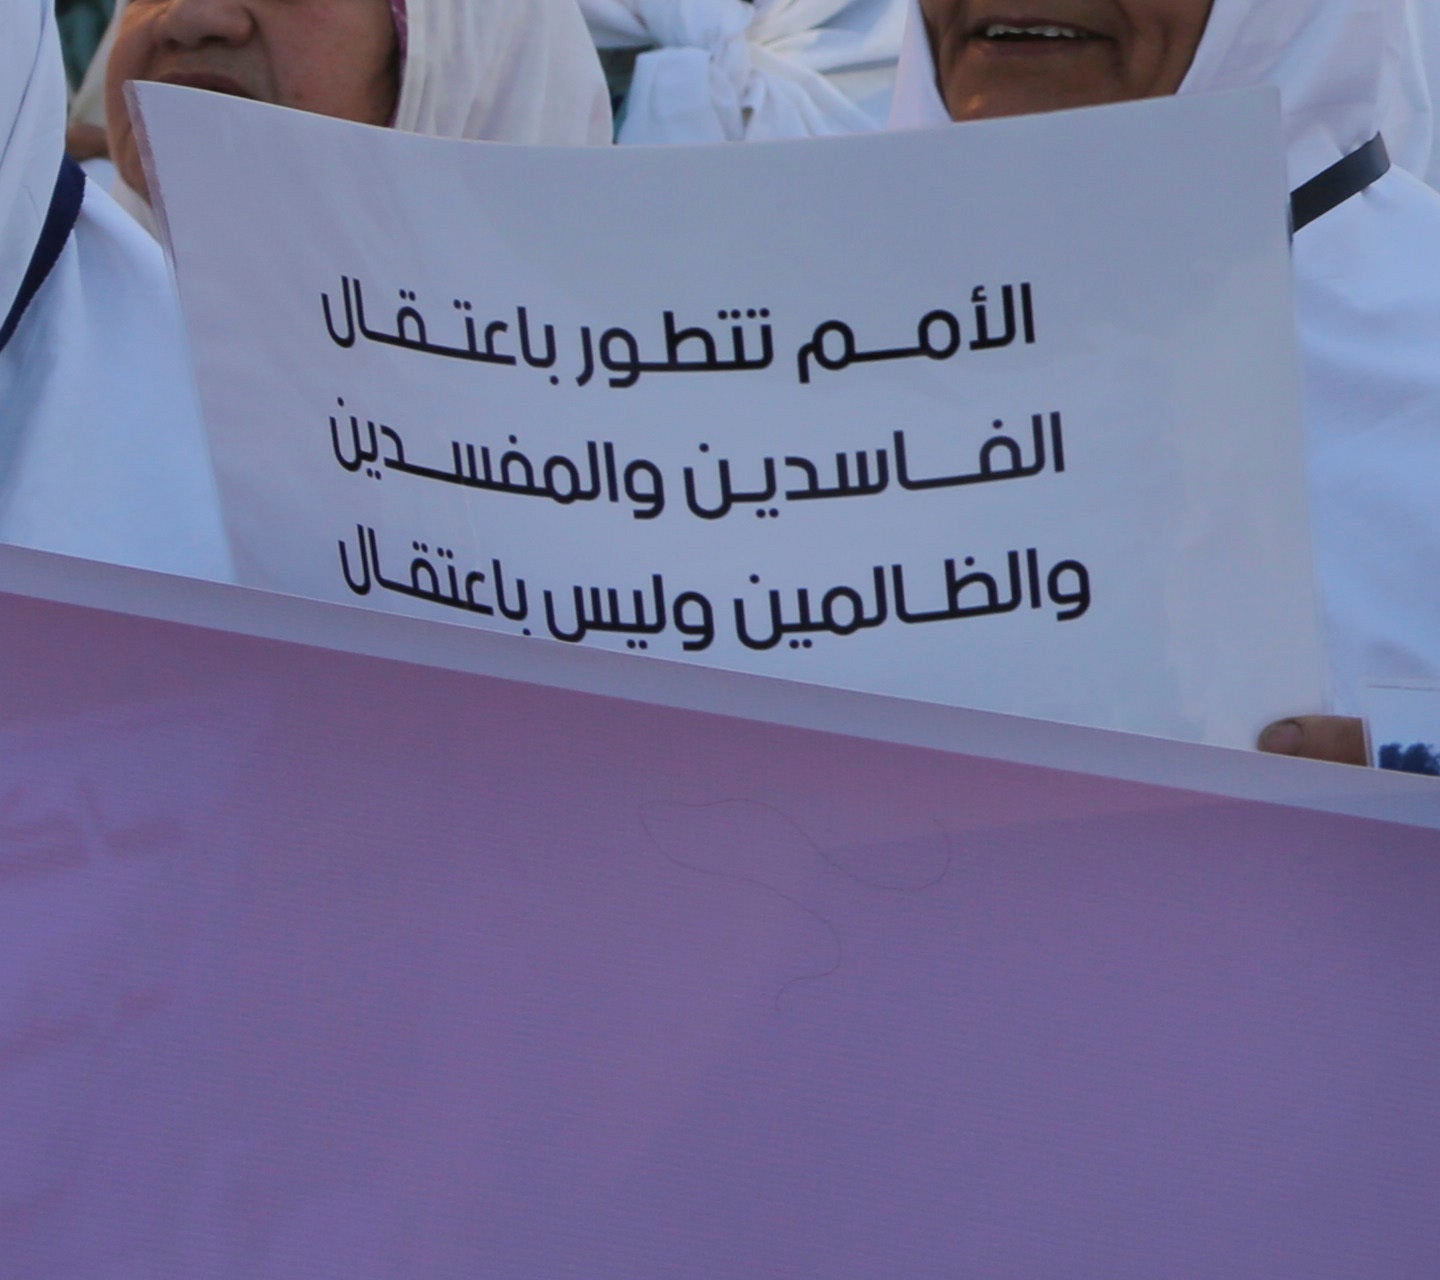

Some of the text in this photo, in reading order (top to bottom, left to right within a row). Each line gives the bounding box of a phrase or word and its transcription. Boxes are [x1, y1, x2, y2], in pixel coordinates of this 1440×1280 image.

[321, 275, 1035, 388] الأمم تتطور باعتقال
[329, 397, 1065, 519] الفاسدين والمفسدين
[338, 523, 1091, 651] والظالمين وليس باعتقال
